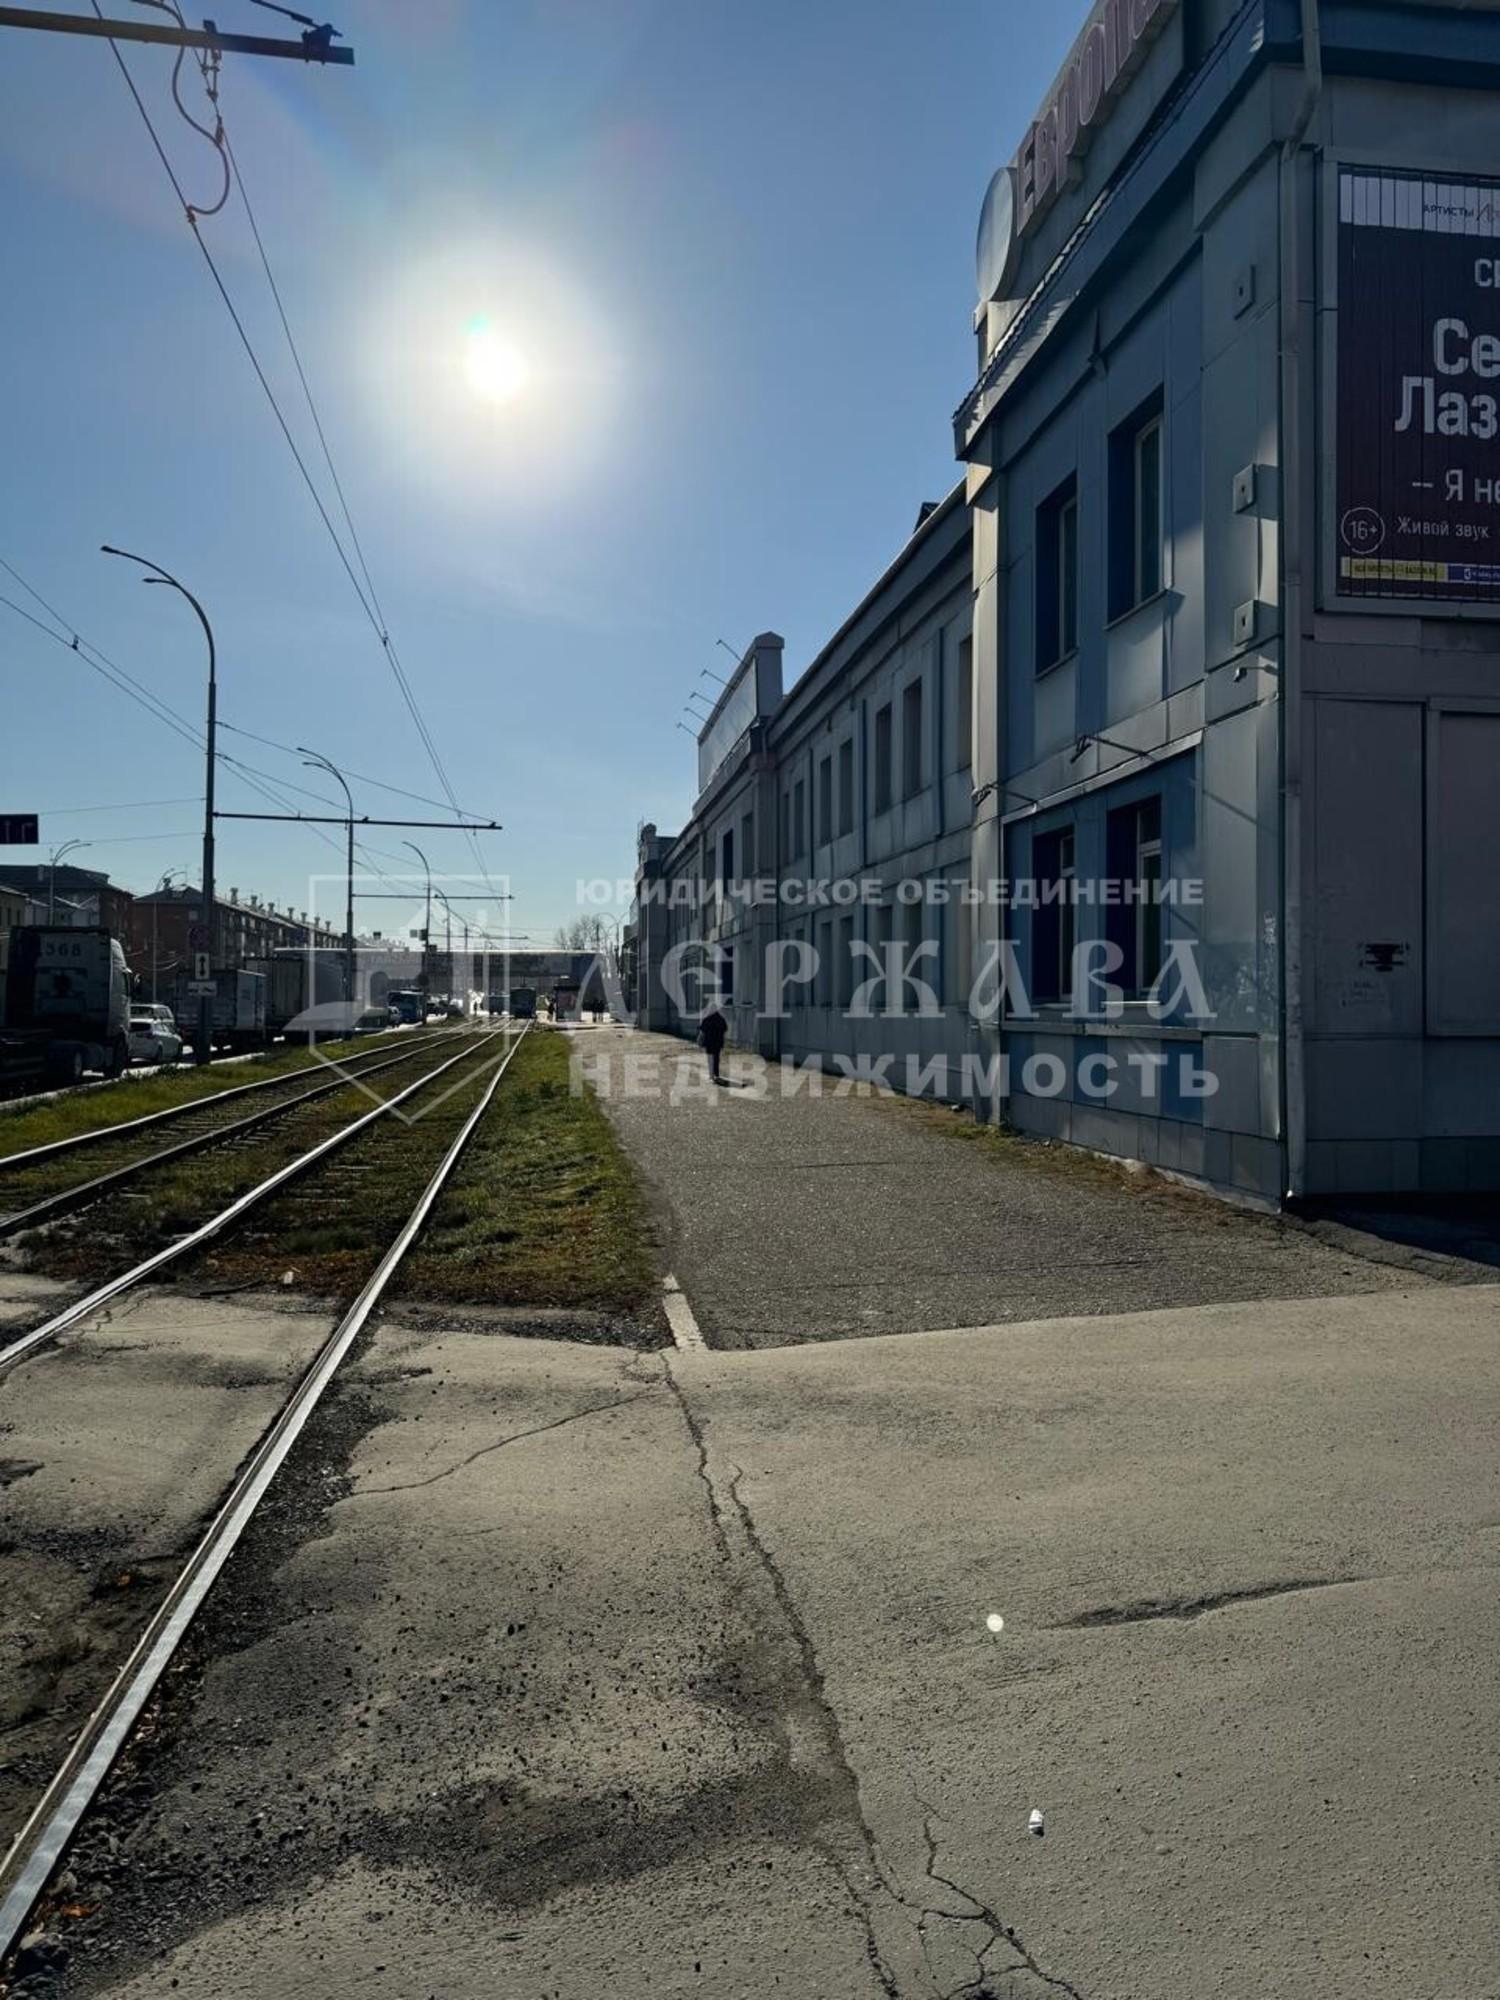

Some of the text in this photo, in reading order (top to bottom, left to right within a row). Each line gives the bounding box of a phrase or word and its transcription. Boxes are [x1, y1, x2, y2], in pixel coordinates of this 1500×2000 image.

[1394, 375, 1498, 439] Лаз
[1446, 469, 1464, 501] Я
[1350, 520, 1378, 540] 16+
[1398, 516, 1490, 541] Живой звук
